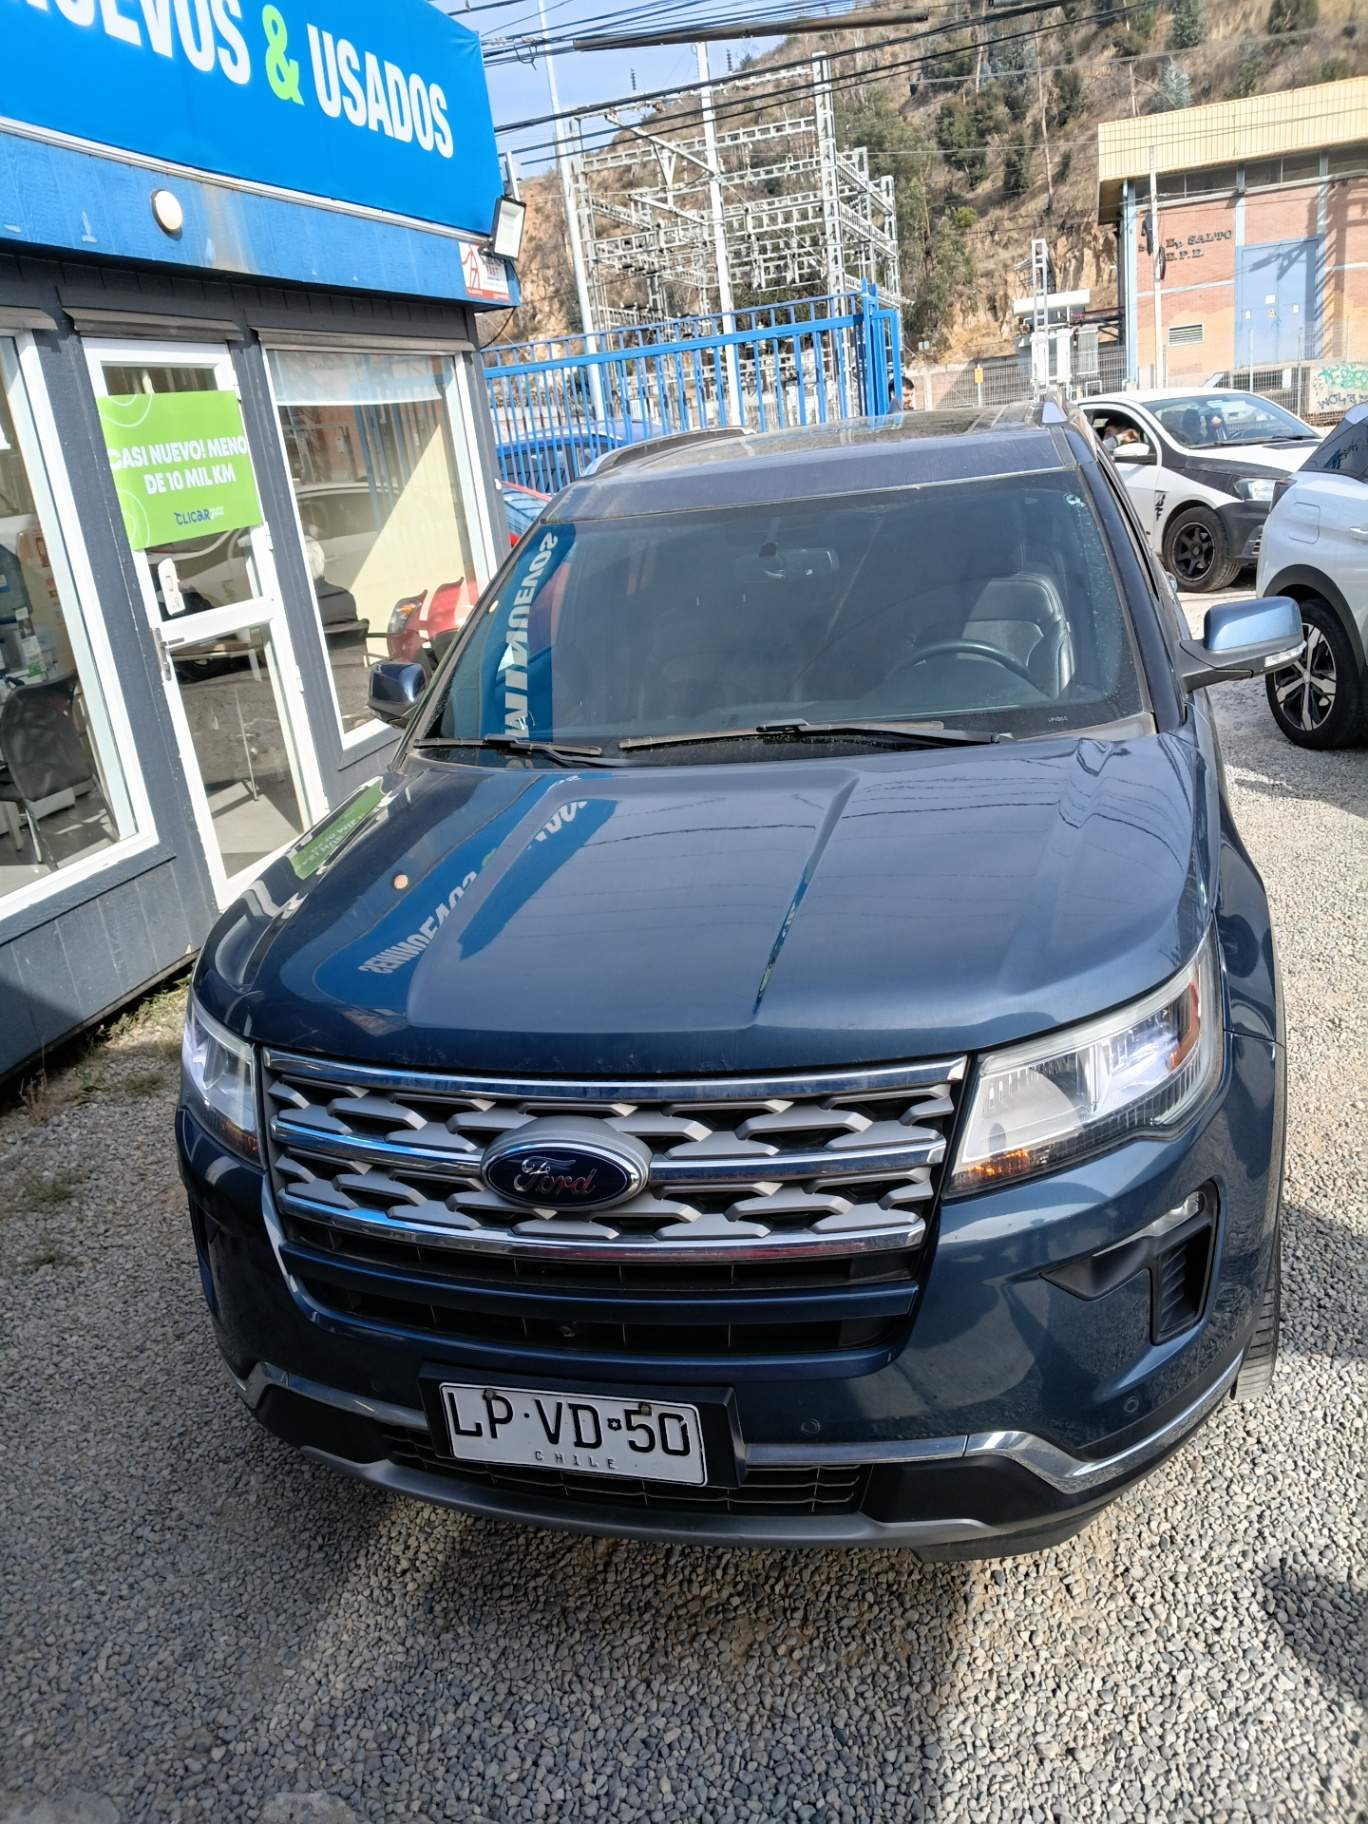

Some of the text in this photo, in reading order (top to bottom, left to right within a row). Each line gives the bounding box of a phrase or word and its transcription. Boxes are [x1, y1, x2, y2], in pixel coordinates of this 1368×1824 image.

[262, 4, 304, 106] &
[307, 23, 454, 159] USADOS
[108, 446, 148, 470] CASI
[149, 439, 207, 466] NUEVO!
[144, 463, 237, 495] DE 10 MIL KM
[513, 1155, 602, 1195] Ford
[535, 1450, 616, 1470] CHILE
